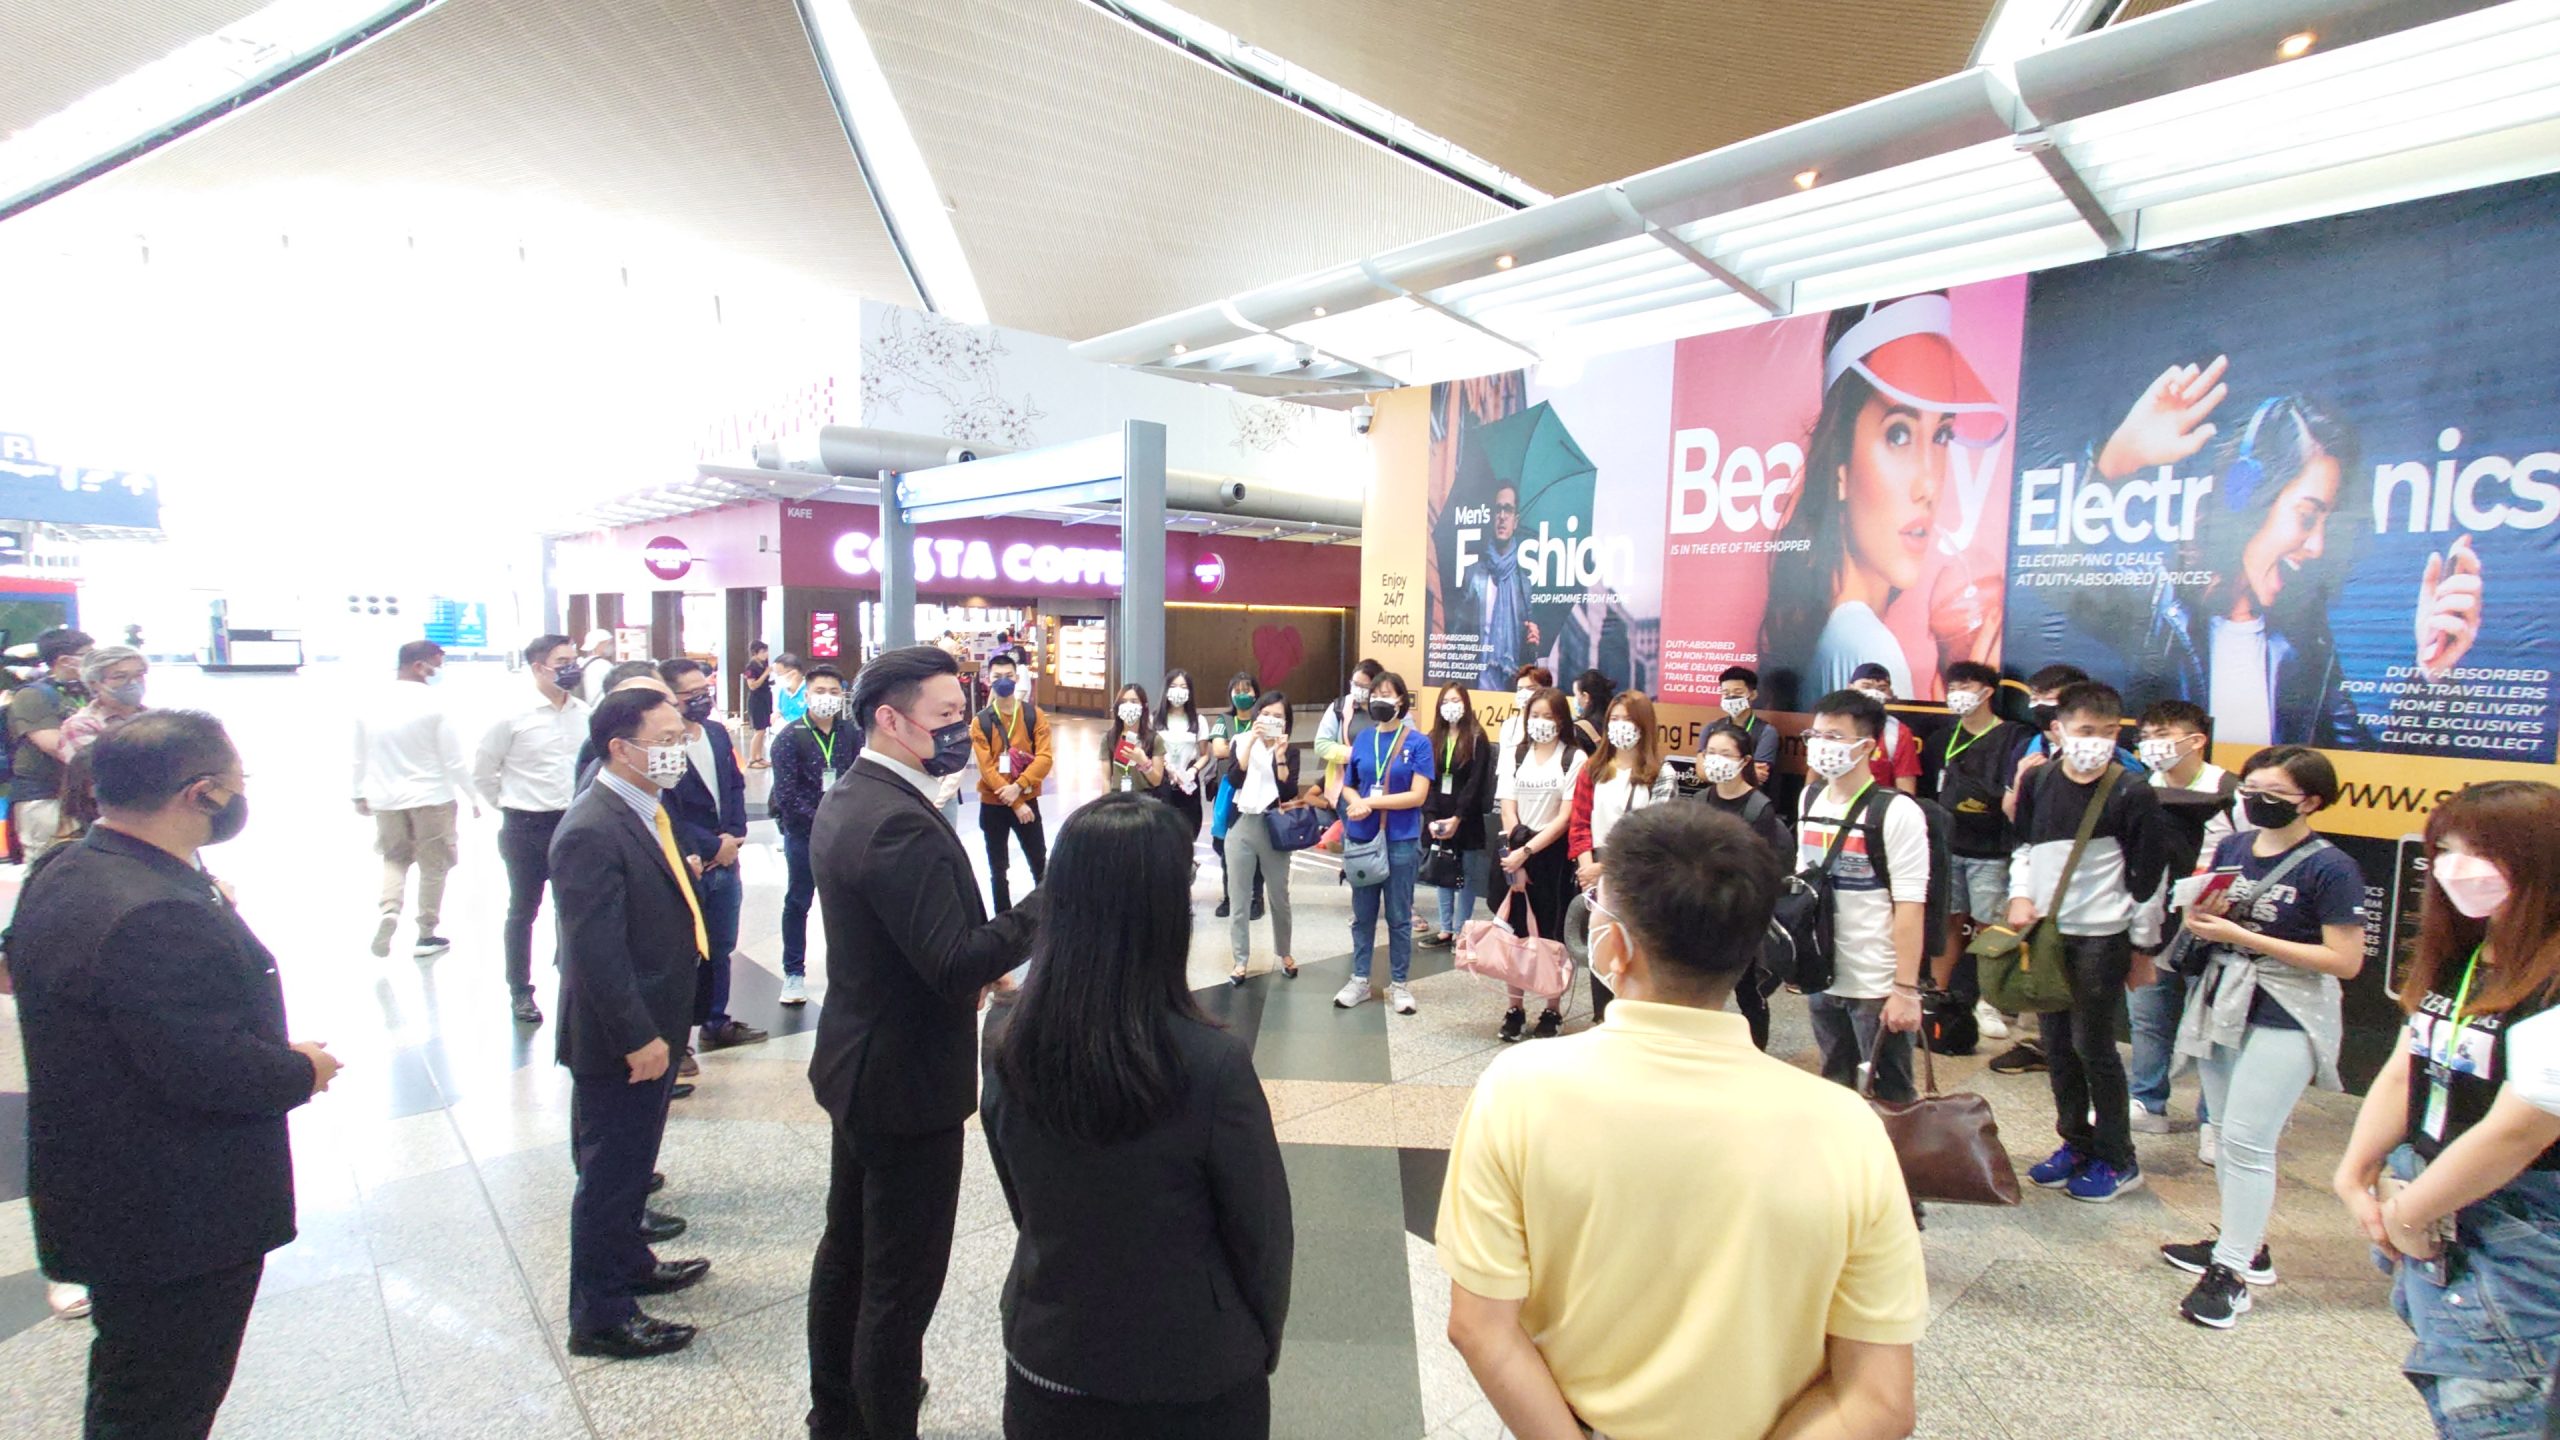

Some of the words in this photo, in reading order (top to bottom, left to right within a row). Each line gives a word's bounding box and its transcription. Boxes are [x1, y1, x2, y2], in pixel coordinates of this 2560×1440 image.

[787, 507, 813, 519] KAFE
[1455, 504, 1491, 525] Men's
[1671, 544, 1679, 555] IS
[1680, 544, 1690, 554] IN
[1692, 543, 1709, 554] THE
[1710, 543, 1727, 554] EYE
[1728, 542, 1743, 553] OF
[1744, 541, 1763, 553] THE
[1763, 540, 1811, 552] SHOPPER
[2017, 553, 2112, 568] ELECTRIFYING
[2115, 552, 2164, 566] DEALS
[1382, 574, 1407, 590] Enjoy
[2016, 573, 2035, 586] AT
[2035, 572, 2155, 586] DUTY-ABSORBED
[2158, 571, 2213, 585] PRICES
[1383, 592, 1404, 606] 24/7
[1531, 594, 1552, 604] SHOP
[1552, 594, 1583, 603] HOMME
[1583, 594, 1606, 603] FROM
[1378, 612, 1409, 628] Airport
[1371, 631, 1415, 648] Shopping
[1429, 633, 1479, 642] DUTY-ABSORBED
[1429, 643, 1441, 651] FOR
[1442, 644, 1494, 653] NON-TRAVELLERS
[1665, 640, 1735, 650] DUTY-ABSORBED
[1448, 653, 1477, 661] DELIVERY
[1665, 652, 1682, 660] FOR
[1683, 653, 1758, 663] NON-TRAVELLERS
[1429, 661, 1450, 669] TRAVEL
[1451, 663, 1487, 671] EXCLUSIVES
[1664, 662, 1689, 671] HOME
[1428, 670, 1444, 678] CLICK
[1451, 671, 1478, 680] COLLECT
[1664, 672, 1694, 682] TRAVEL
[2386, 666, 2549, 682] DUTY-ABSORBED
[1663, 683, 1687, 693] CLICK
[1688, 684, 1695, 693] &
[2339, 681, 2375, 693] FOR
[2379, 682, 2549, 699] NON-TRAVELLERS
[2389, 698, 2446, 713] HOME
[2449, 701, 2548, 716] DELIVERY
[2356, 713, 2423, 728] TRAVEL
[2426, 717, 2544, 734] EXCLUSIVES
[2380, 731, 2434, 745] CLICK
[2436, 734, 2450, 746] &
[2454, 735, 2544, 751] COLLECT
